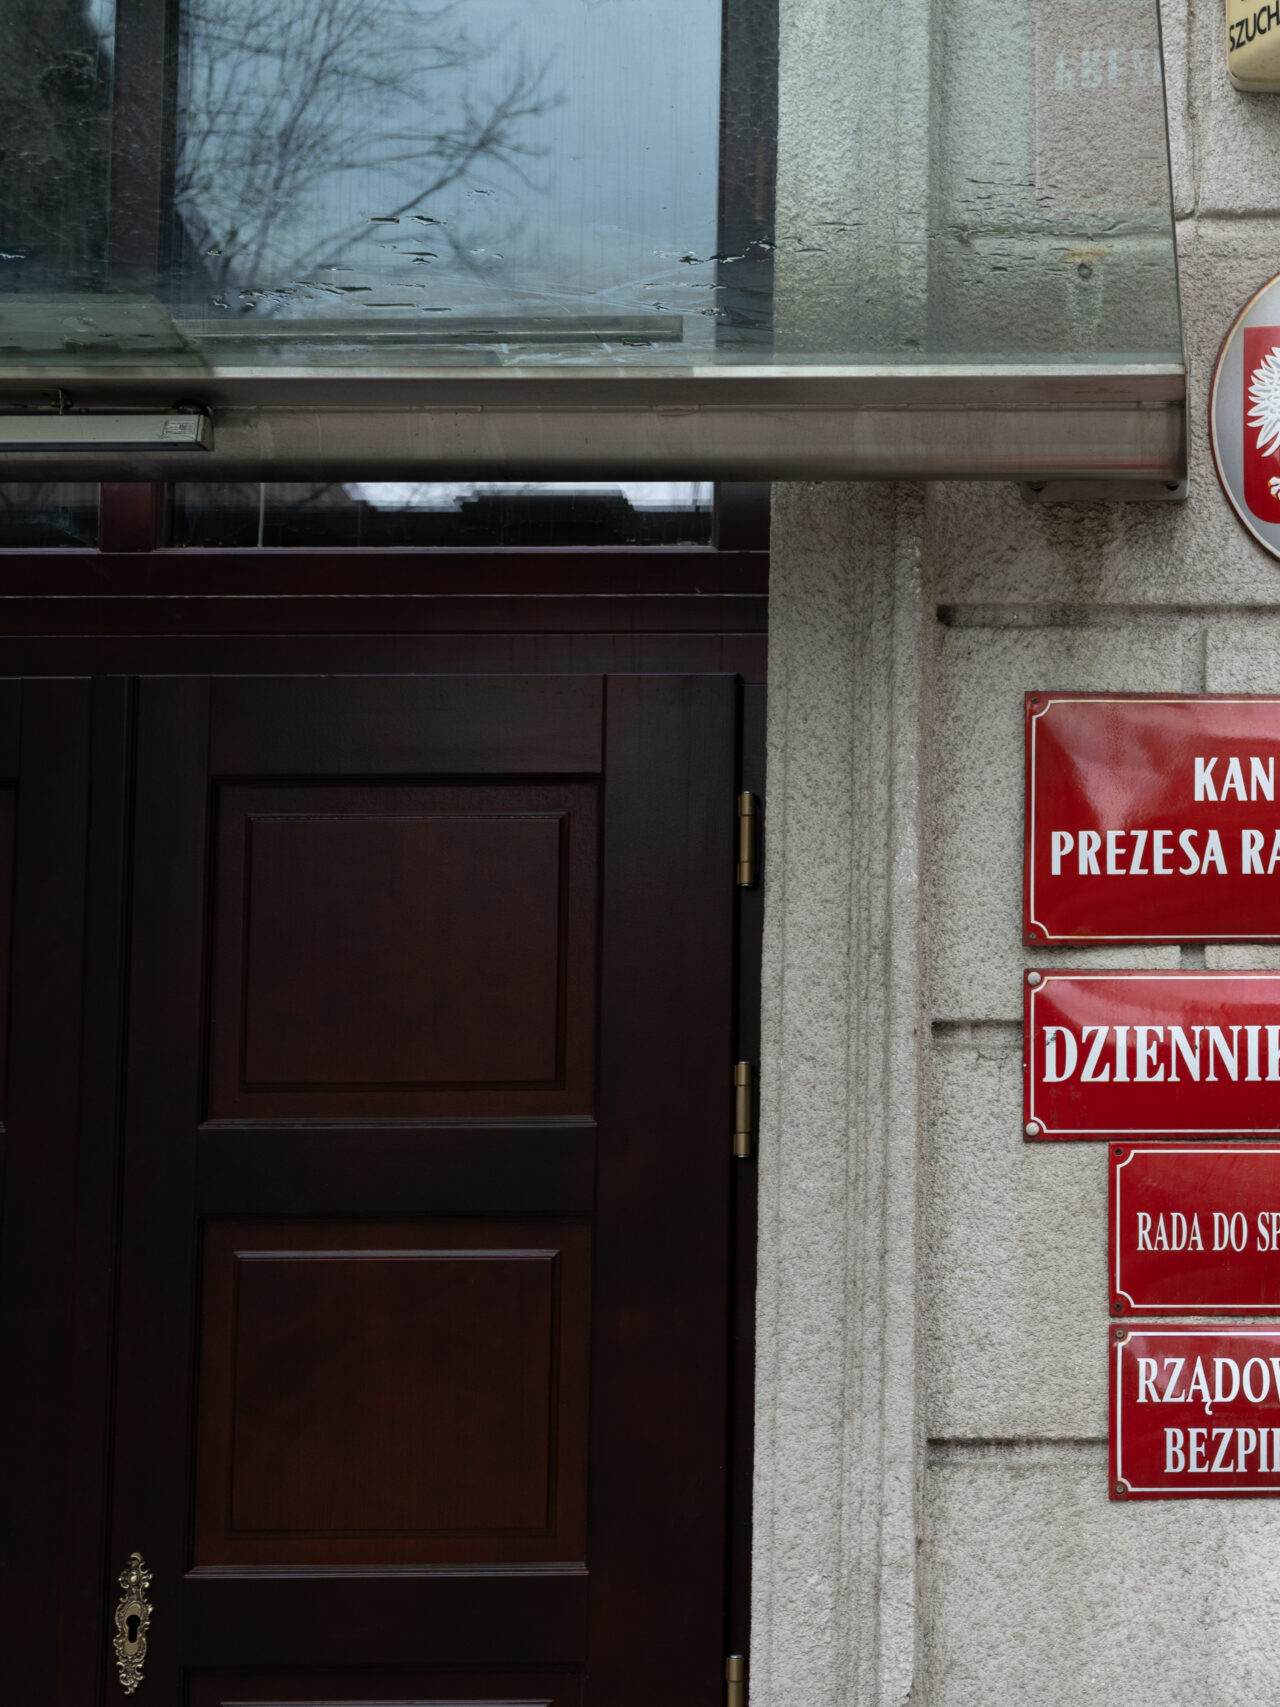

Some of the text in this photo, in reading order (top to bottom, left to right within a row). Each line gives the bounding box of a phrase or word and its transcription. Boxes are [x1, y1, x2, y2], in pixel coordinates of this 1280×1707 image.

[1051, 829, 1228, 876] PREZESA
[1136, 1212, 1205, 1252] RADA
[1212, 1211, 1248, 1252] DO
